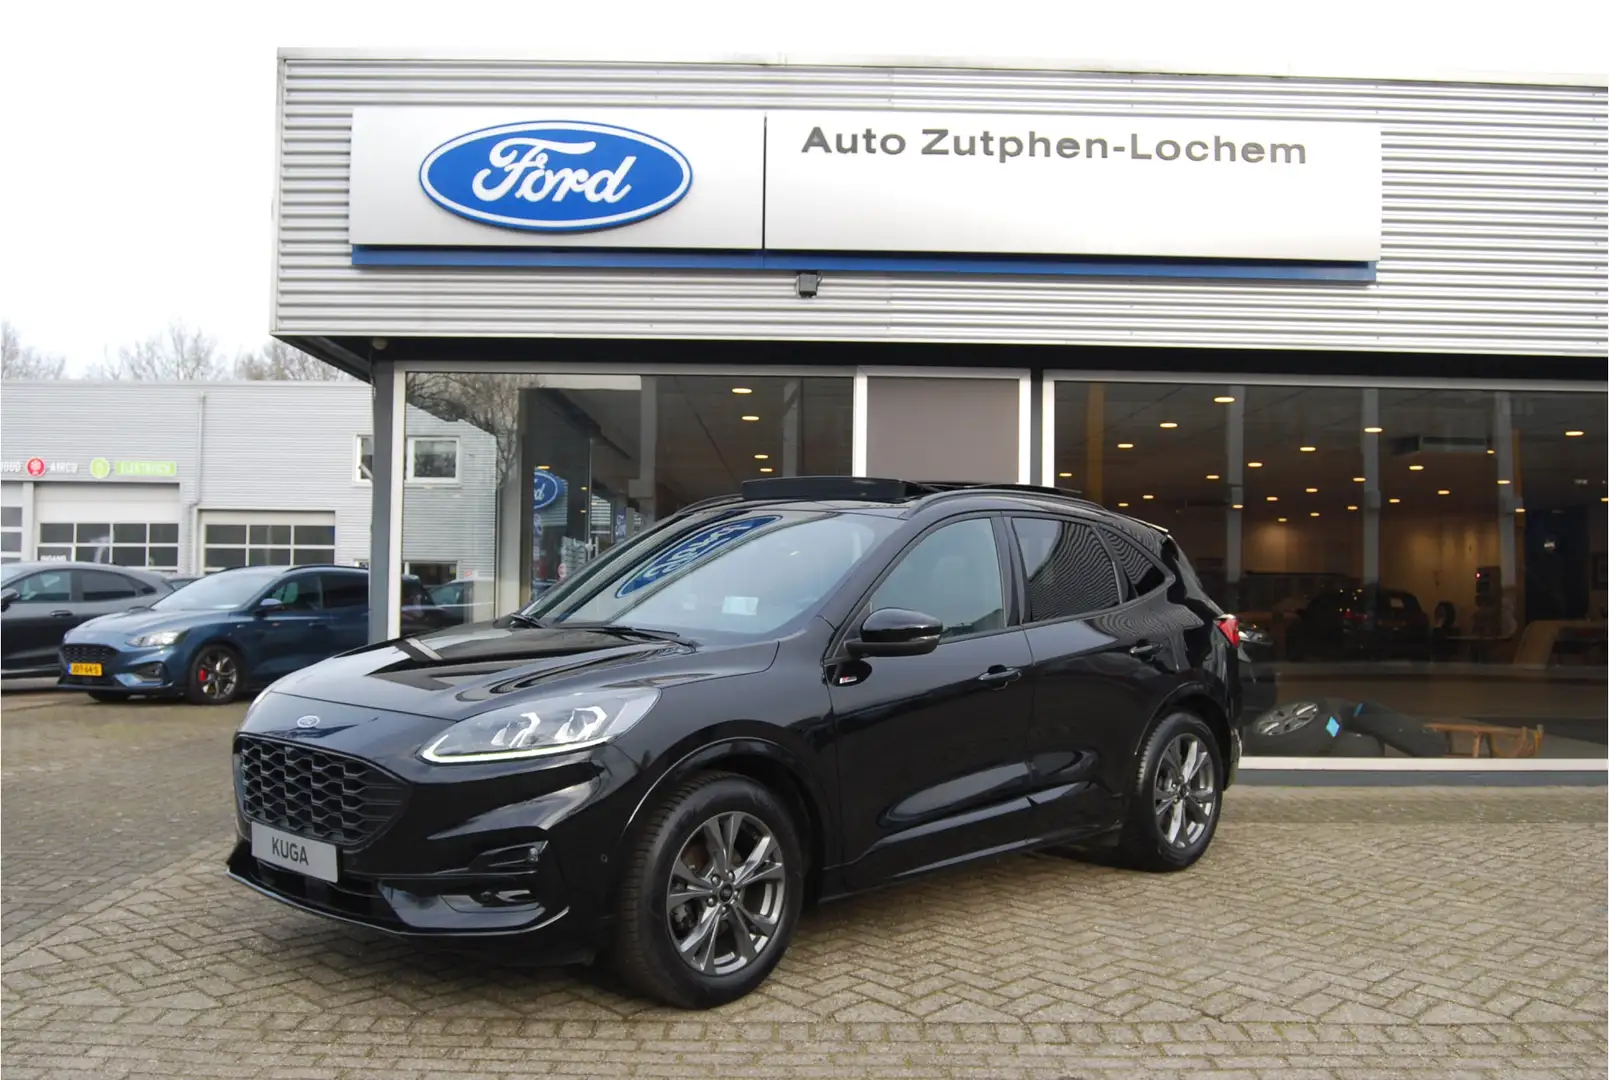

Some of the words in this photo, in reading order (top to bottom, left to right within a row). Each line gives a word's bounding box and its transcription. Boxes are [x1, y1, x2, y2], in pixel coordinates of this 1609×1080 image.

[801, 126, 906, 155] Auto
[921, 128, 1306, 164] Zutphen-Lochem
[471, 137, 637, 203] Ford
[272, 836, 309, 866] KUGA
